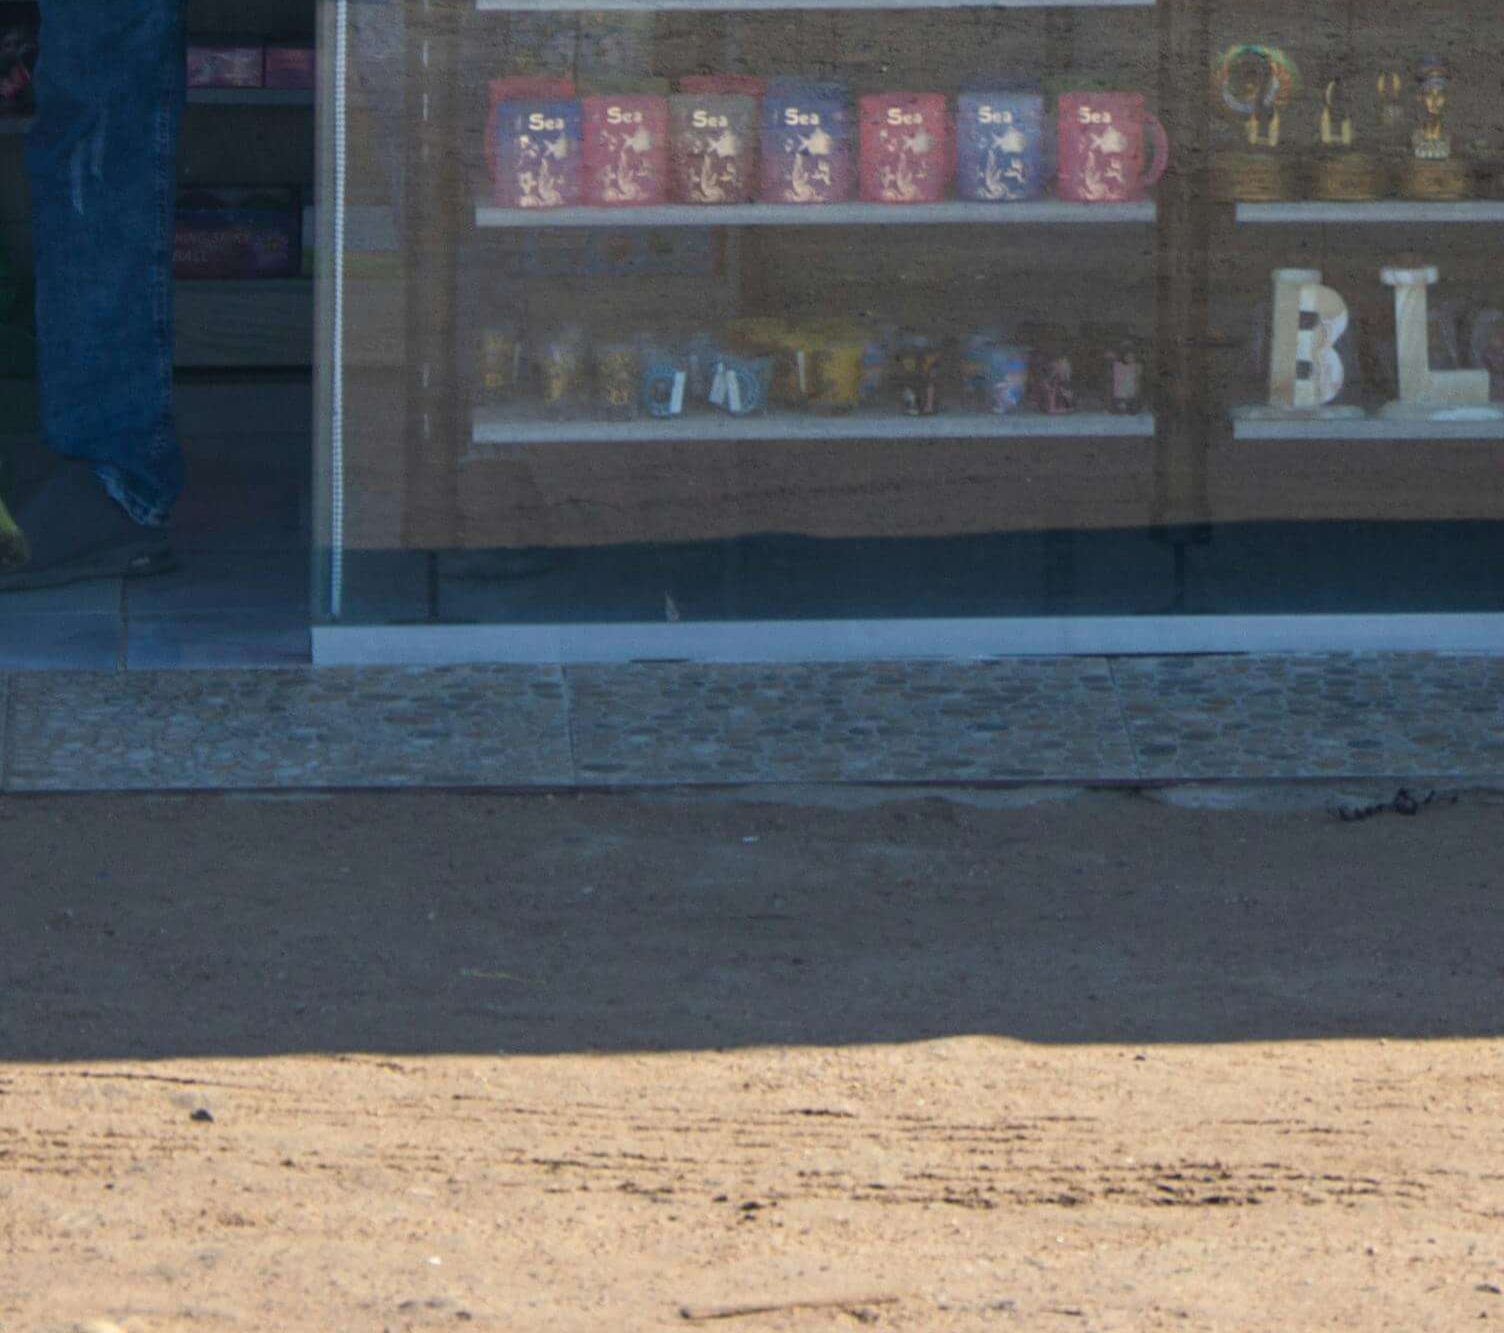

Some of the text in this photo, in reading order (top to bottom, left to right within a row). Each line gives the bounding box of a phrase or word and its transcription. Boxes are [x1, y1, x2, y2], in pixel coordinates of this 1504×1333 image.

[529, 113, 566, 131] Sea
[606, 107, 644, 126] Sea
[692, 110, 729, 128] Sea
[784, 108, 821, 126] Sea
[887, 108, 924, 126] Sea
[978, 106, 1013, 124] Sea
[1078, 106, 1113, 124] Sea
